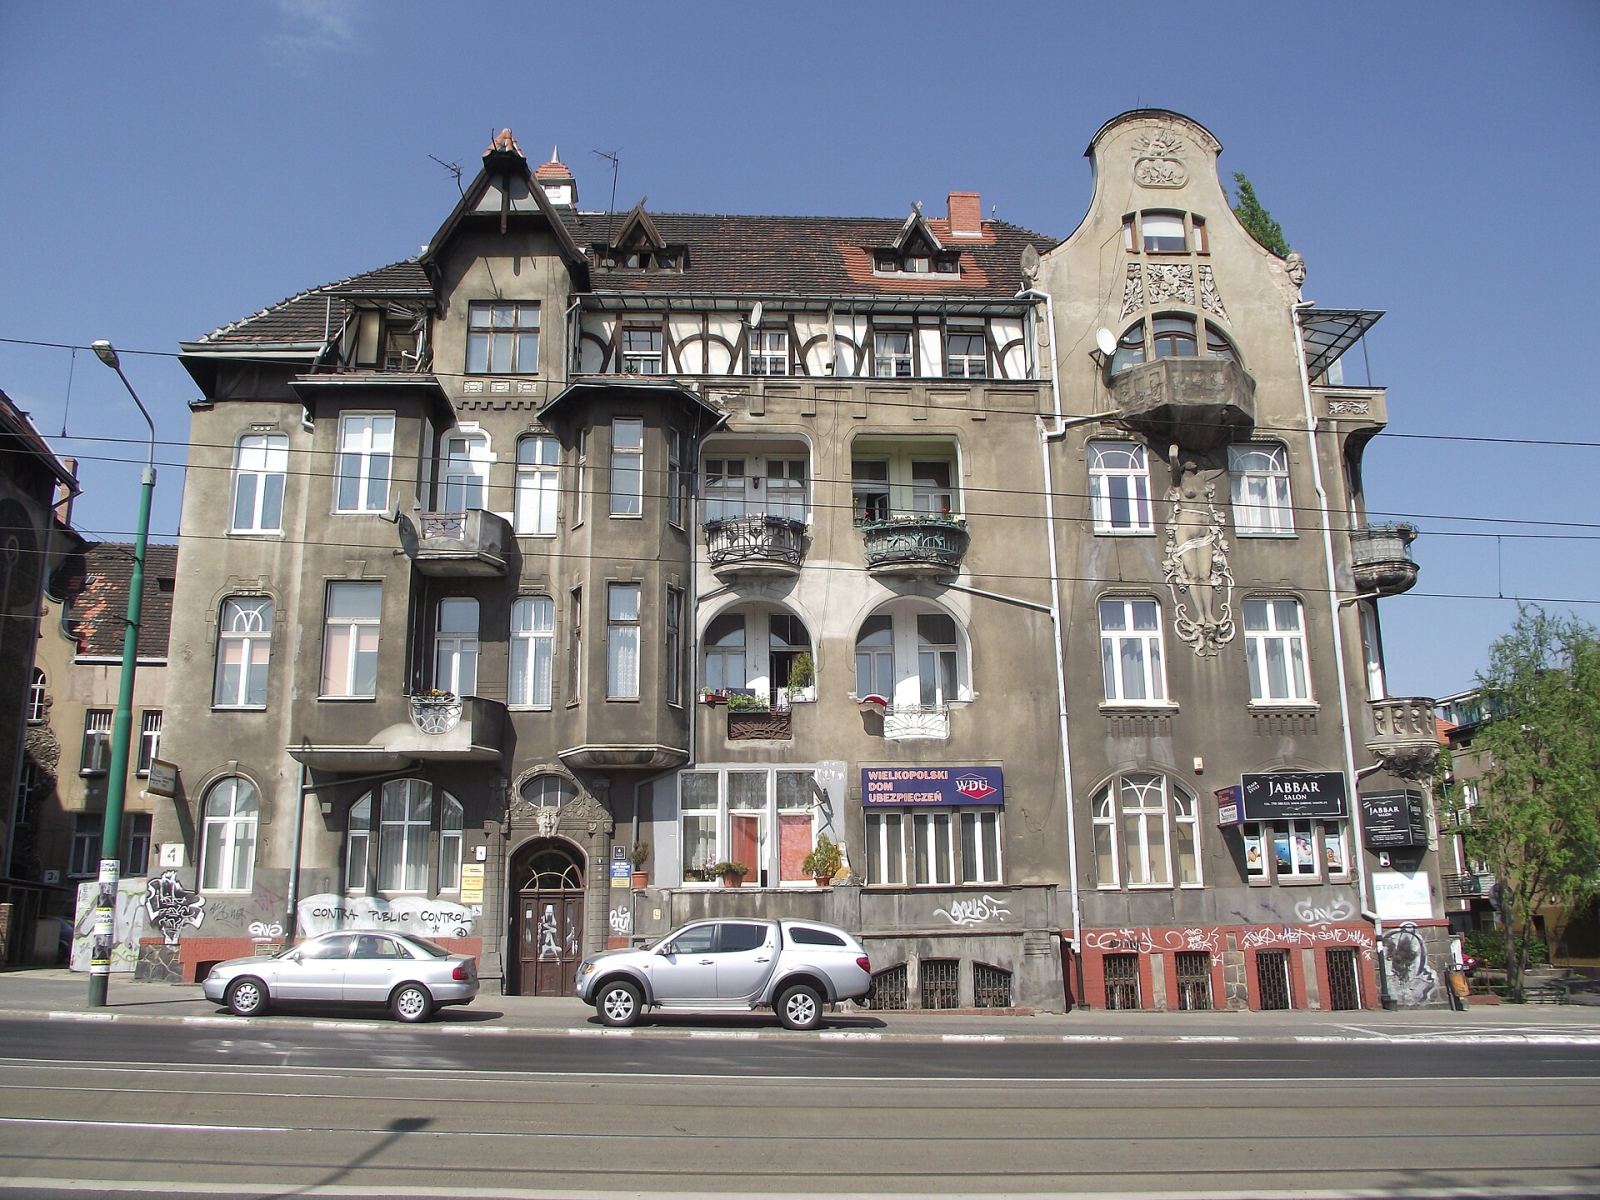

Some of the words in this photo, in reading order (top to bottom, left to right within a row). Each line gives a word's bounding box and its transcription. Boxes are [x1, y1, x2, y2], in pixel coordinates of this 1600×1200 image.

[868, 770, 949, 780] WIELKOPOLSKI
[868, 782, 894, 792] DOM
[955, 780, 988, 792] WDU
[1269, 781, 1321, 796] JABBAR
[868, 790, 942, 803] UBEZPIECZEŃ
[1369, 806, 1400, 816] JABBAR
[1375, 883, 1406, 891] START
[312, 907, 359, 921] CONTRA
[368, 910, 410, 922] PUBLIC
[420, 910, 472, 924] CONTROL
